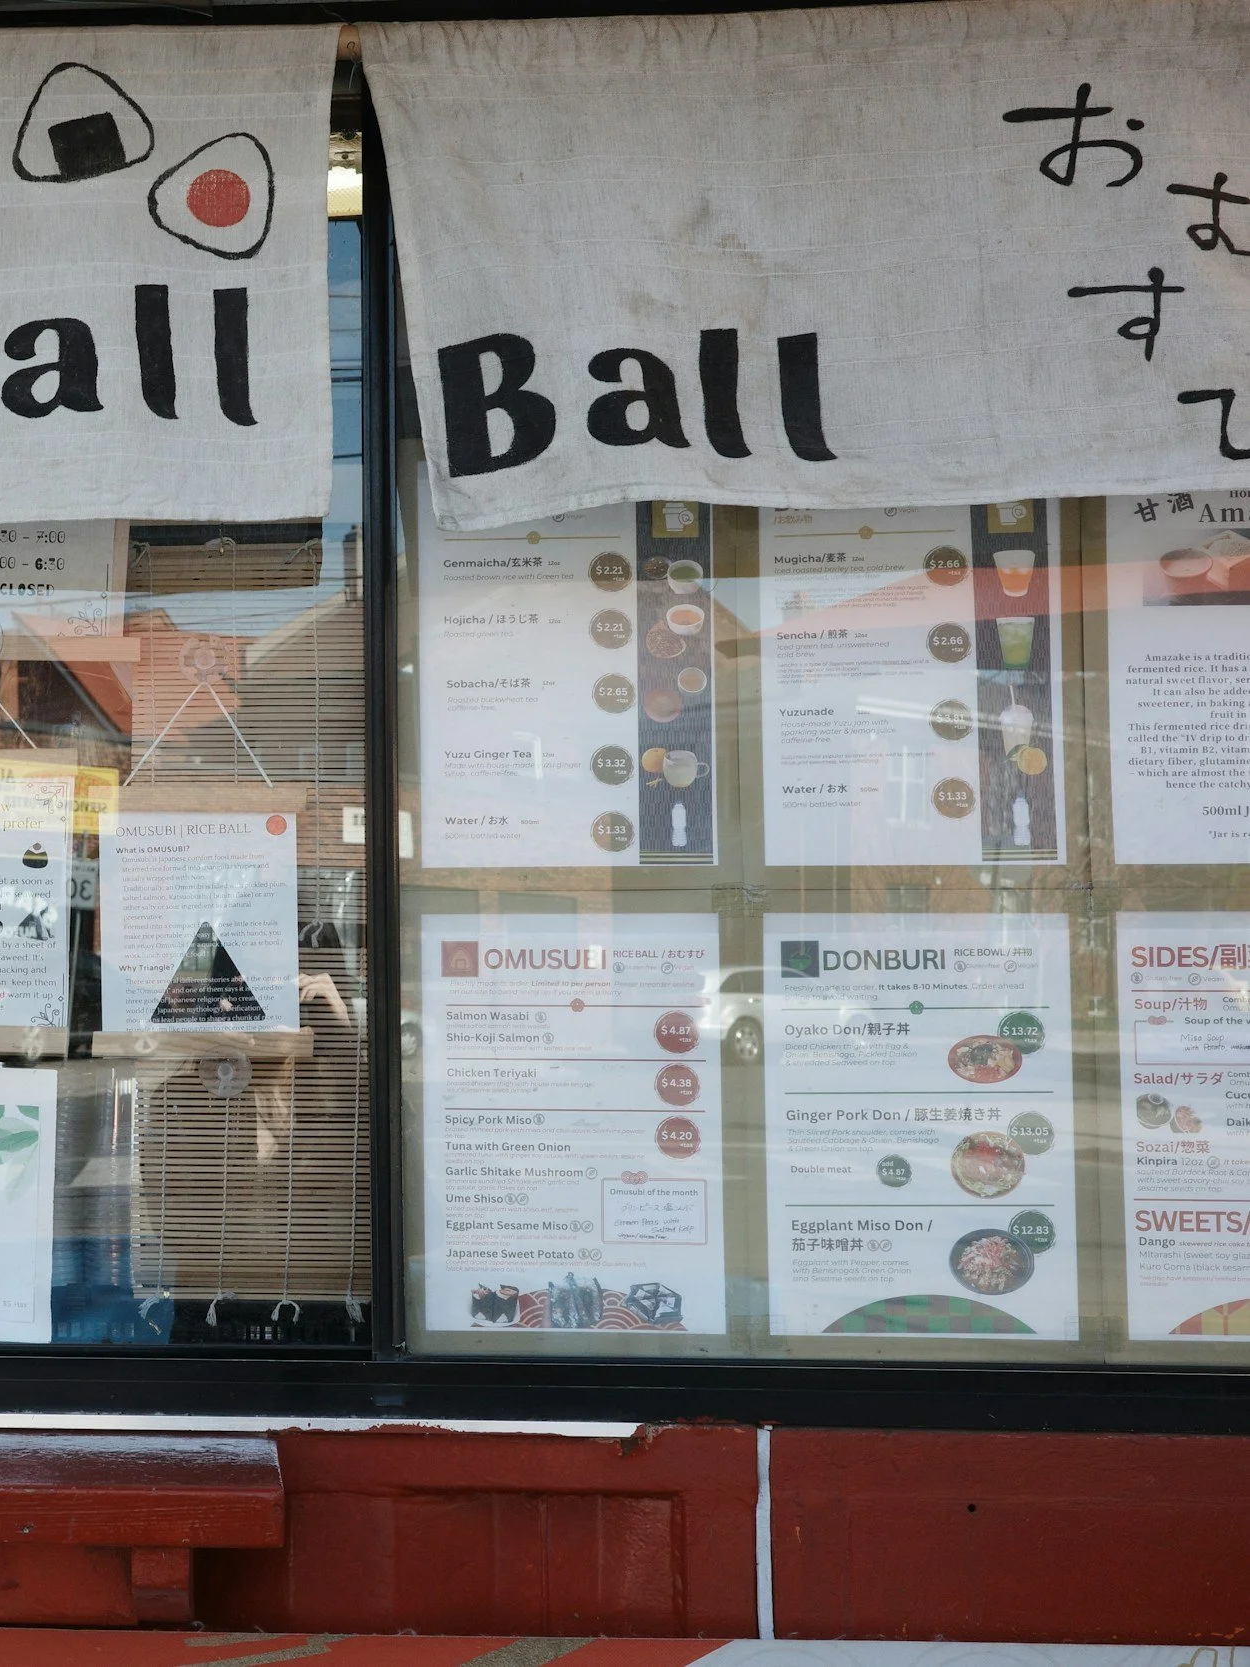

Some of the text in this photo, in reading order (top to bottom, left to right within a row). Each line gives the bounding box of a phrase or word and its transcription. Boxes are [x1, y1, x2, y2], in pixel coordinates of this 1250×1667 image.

[438, 328, 838, 477] Ball
[1134, 492, 1194, 523] 甘酒
[1198, 503, 1250, 522] Am
[36, 531, 66, 543] 7:00
[35, 558, 64, 570] 6:30
[444, 557, 542, 568] Genmaicha/玄米茶
[774, 552, 846, 565] Mugicha/麦茶
[443, 573, 475, 581] Roasted
[536, 572, 557, 580] Green
[0, 583, 55, 596] CLOSED
[444, 614, 538, 626] Hojicha ほうじ茶
[777, 629, 847, 640] Sencha 煎茶
[1128, 665, 1206, 673] fermented rice.
[446, 678, 531, 689] Sobacha/そば茶
[1126, 677, 1163, 685] natural
[1198, 676, 1232, 685] flavor,
[779, 707, 834, 717] Yuzunade
[444, 749, 532, 760] Yuzu Ginger Tea
[1128, 757, 1196, 767] dietary fiber,
[1202, 806, 1241, 816] 500ml
[2, 818, 44, 831] prefer
[445, 816, 508, 825] Water お水
[116, 823, 251, 837] OMUSUBI RICE BALL
[147, 845, 190, 853] OMUSUBI?
[484, 948, 705, 970] OMUSUBI RICE BALL おむすび
[822, 950, 946, 971] DONBURI
[954, 948, 975, 957] RICE
[978, 948, 1005, 956] BOWL
[1131, 944, 1250, 970] SIDES/副
[139, 963, 174, 972] Triangle?
[1134, 998, 1208, 1012] Soup/汁物
[446, 1012, 529, 1021] Salmon Wasabi
[1184, 1017, 1242, 1025] Soup of the
[785, 1022, 910, 1037] Oyako Don/親子丼
[446, 1033, 540, 1044] Shio-Koji Salmon
[447, 1068, 537, 1080] Chicken Teriyaki
[1134, 1072, 1223, 1085] Salad/サラダ
[445, 1115, 532, 1126] Spicy Pork Miso
[786, 1108, 1001, 1123] Ginger Pork Don 豚生姜焼き丼
[446, 1142, 570, 1152] Tuna with Green Onion
[1136, 1140, 1210, 1153] Sozai/惣菜
[1137, 1156, 1203, 1166] Kinpira 12oz
[446, 1166, 584, 1178] Garlic Shitake Mushroom
[791, 1165, 825, 1173] Double
[610, 1188, 645, 1196] Omusubi
[647, 1188, 655, 1196] of
[673, 1189, 698, 1197] month
[446, 1194, 503, 1204] Ume Shiso
[446, 1220, 568, 1232] Eggplant Sesame Miso
[792, 1219, 923, 1234] Eggplant Miso Don
[792, 1238, 864, 1252] 茄子味噌丼
[1139, 1236, 1176, 1247] Dango
[446, 1249, 574, 1260] Japanese Sweet Potato
